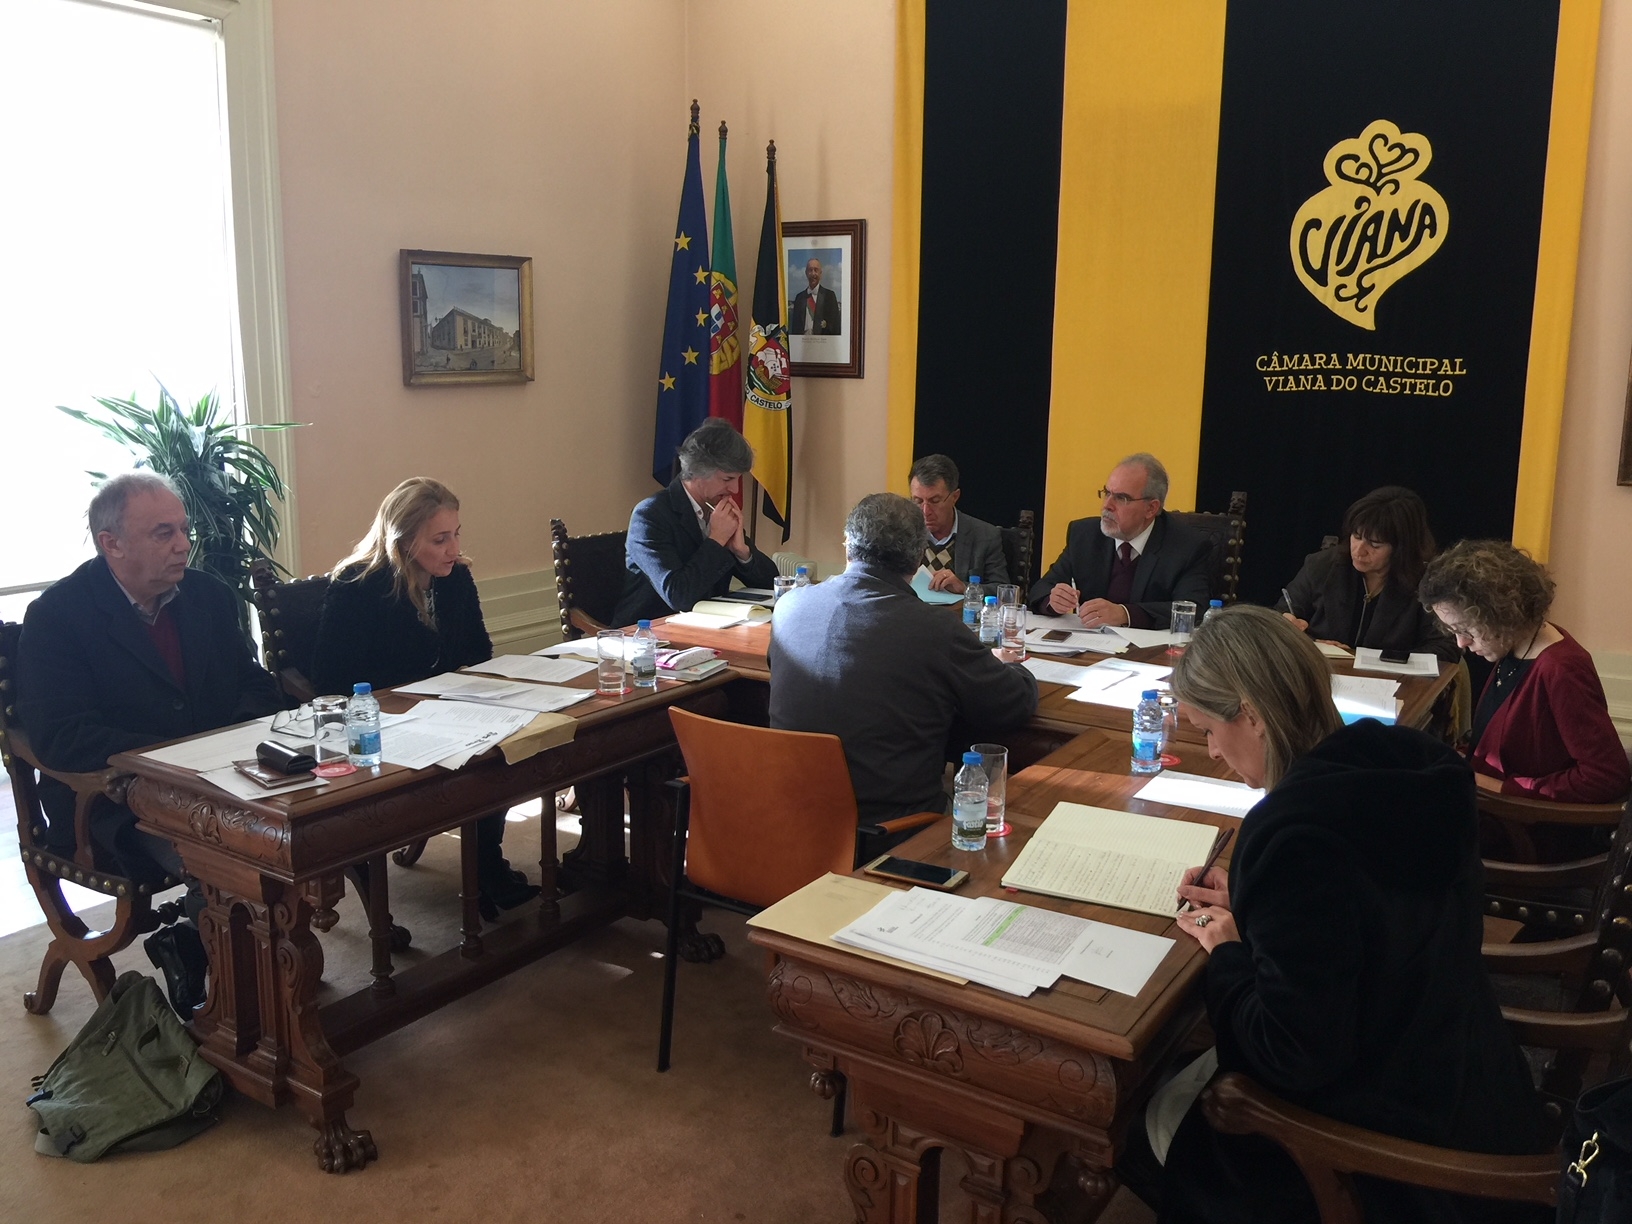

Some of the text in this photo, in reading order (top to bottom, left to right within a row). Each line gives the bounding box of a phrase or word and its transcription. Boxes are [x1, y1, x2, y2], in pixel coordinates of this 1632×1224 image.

[1299, 196, 1438, 288] VIANA
[1256, 351, 1467, 375] CÂMARA MUNICIPAL
[1264, 375, 1453, 397] VIANA DO CASTELO
[750, 395, 783, 409] CASTELO
